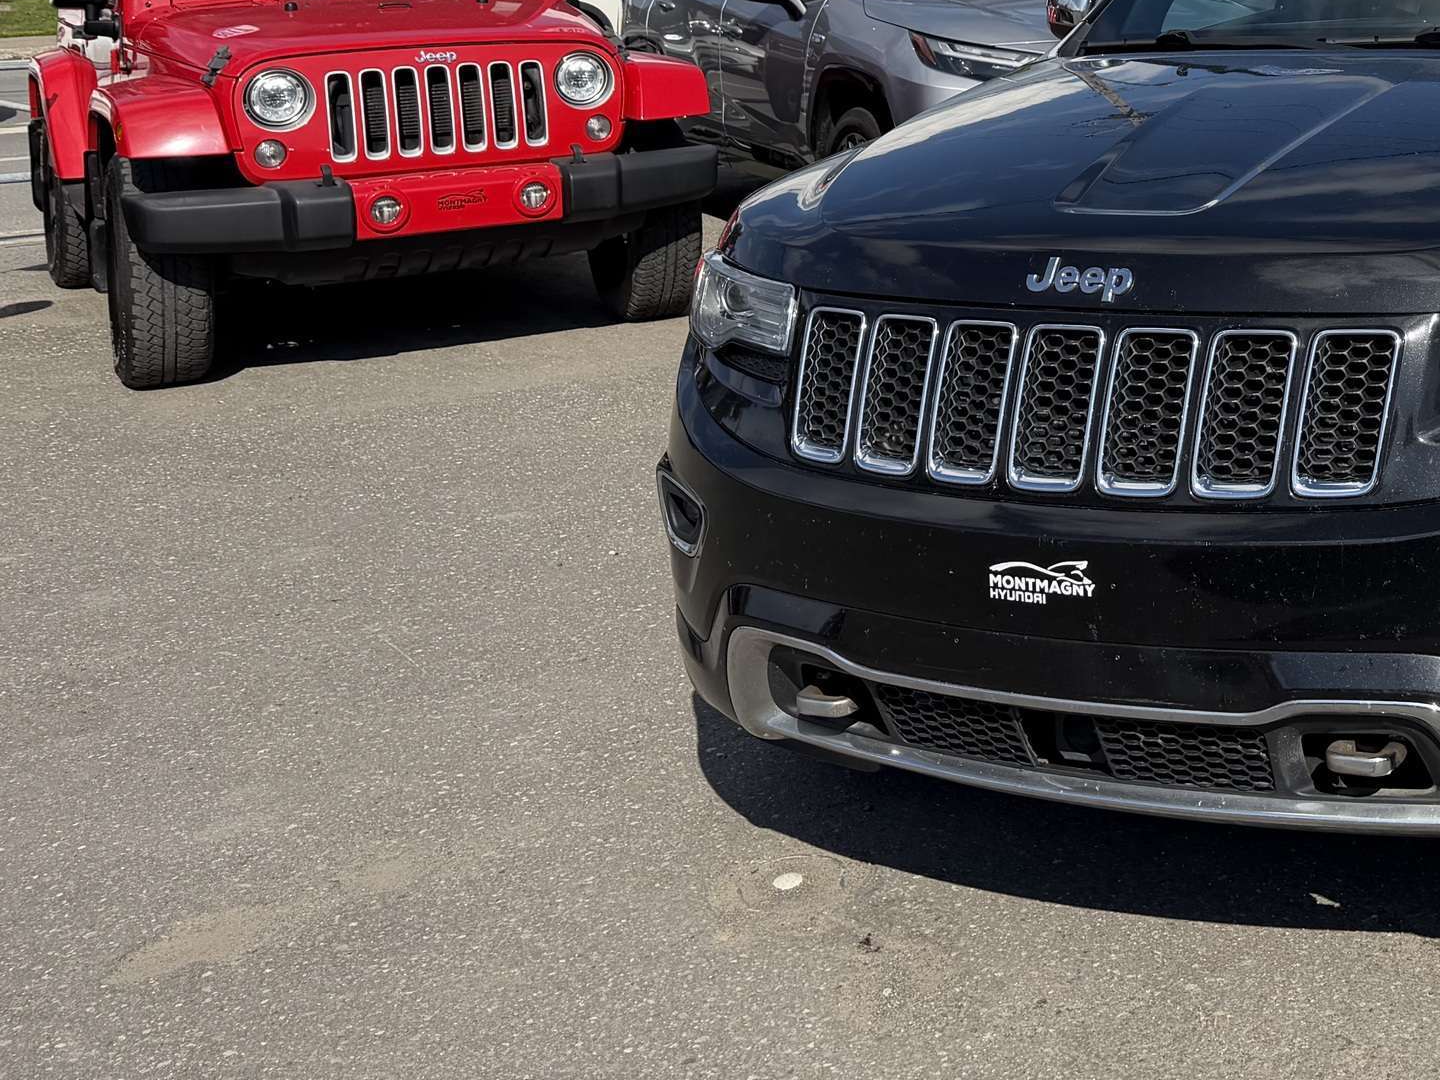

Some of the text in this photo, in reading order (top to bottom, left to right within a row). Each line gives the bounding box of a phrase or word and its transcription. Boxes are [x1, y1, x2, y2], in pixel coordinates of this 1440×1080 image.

[415, 50, 457, 63] Jeep
[1026, 256, 1135, 303] Jeep
[989, 573, 1096, 598] MONTMAGNY
[990, 587, 1047, 605] HYUNDAI
